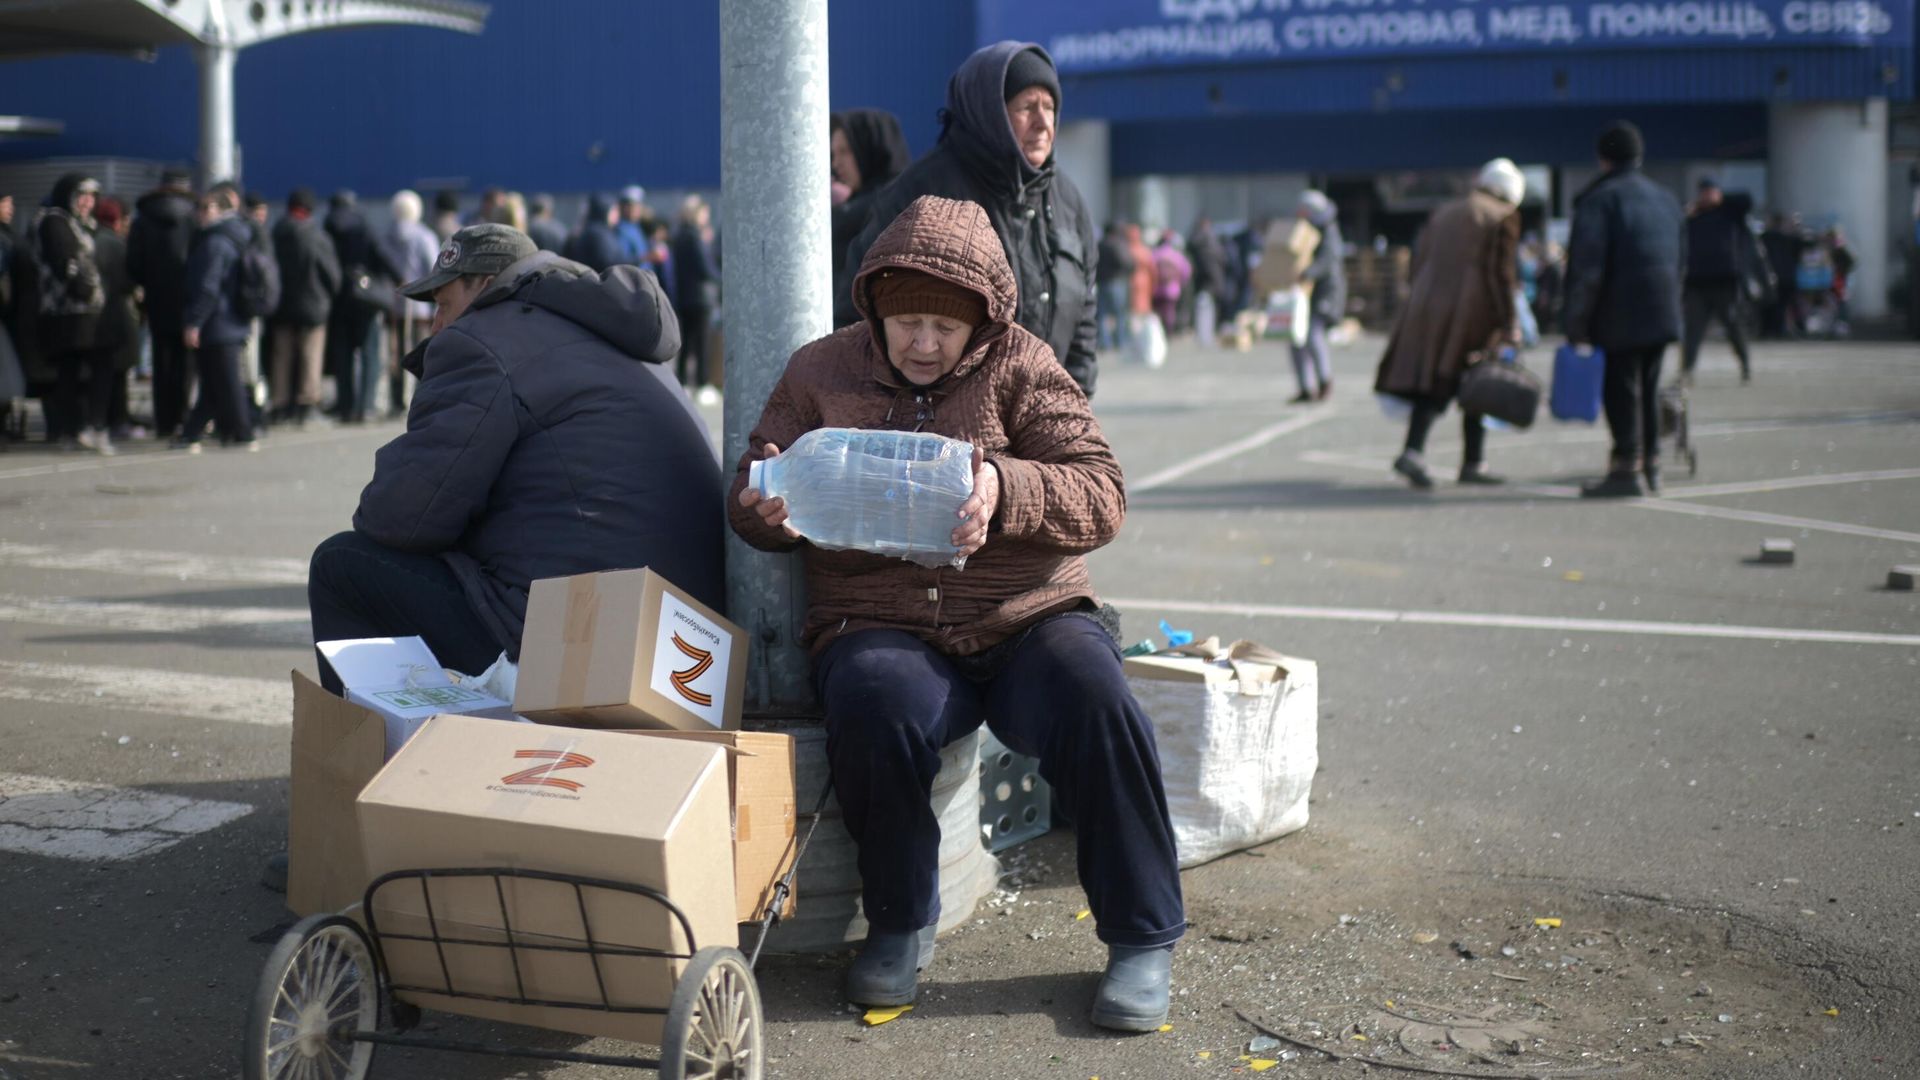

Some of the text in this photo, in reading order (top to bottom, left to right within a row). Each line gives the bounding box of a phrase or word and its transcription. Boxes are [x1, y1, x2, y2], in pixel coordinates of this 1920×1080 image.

[1284, 9, 1484, 49] СТОЛОВАЯ,
[1588, 1, 1776, 40] ПОМОЩЬ,
[1783, 0, 1892, 34] СВЯЗЬ
[670, 629, 714, 707] Z
[501, 749, 595, 792] Z
